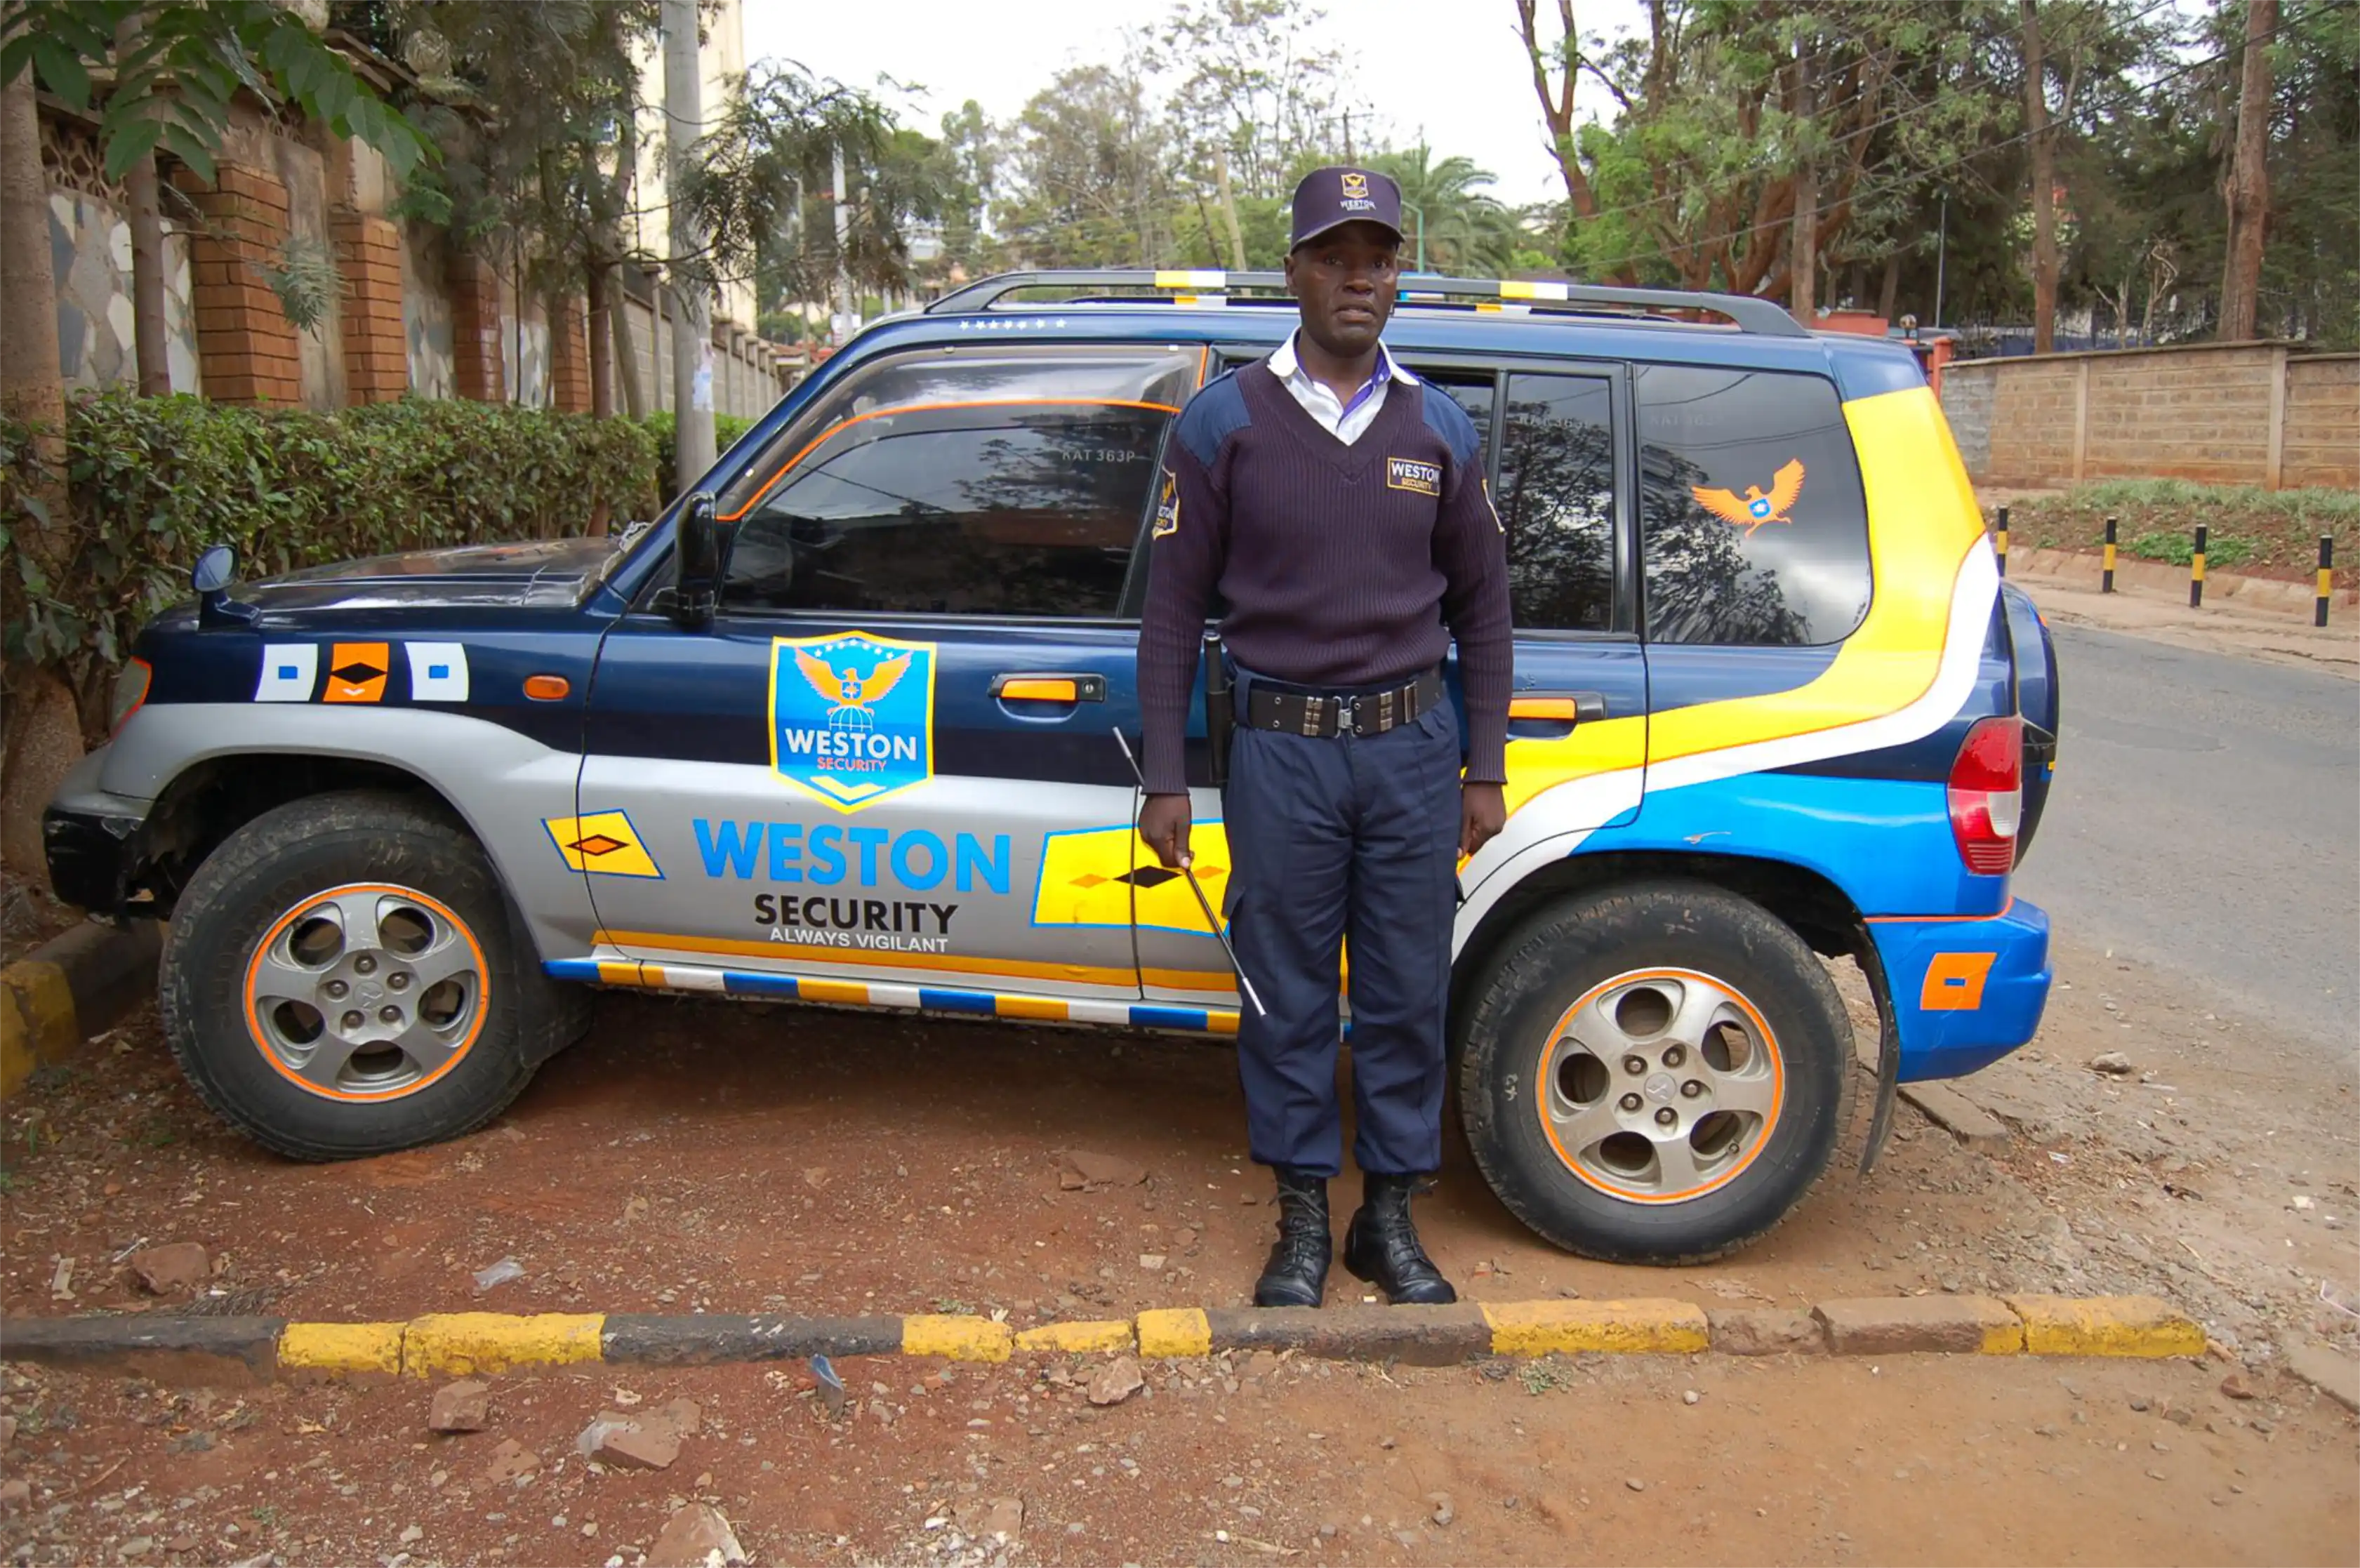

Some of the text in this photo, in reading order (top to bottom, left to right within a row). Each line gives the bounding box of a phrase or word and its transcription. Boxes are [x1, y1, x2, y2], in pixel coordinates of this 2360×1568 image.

[1096, 449, 1135, 463] 363P
[1391, 462, 1440, 484] WESTON
[785, 728, 917, 762] WESTON
[816, 756, 887, 772] SECURITY
[693, 818, 1011, 894] WESTON
[755, 893, 959, 935] SECURITY
[769, 927, 948, 953] ALWAYS VIGILANT
